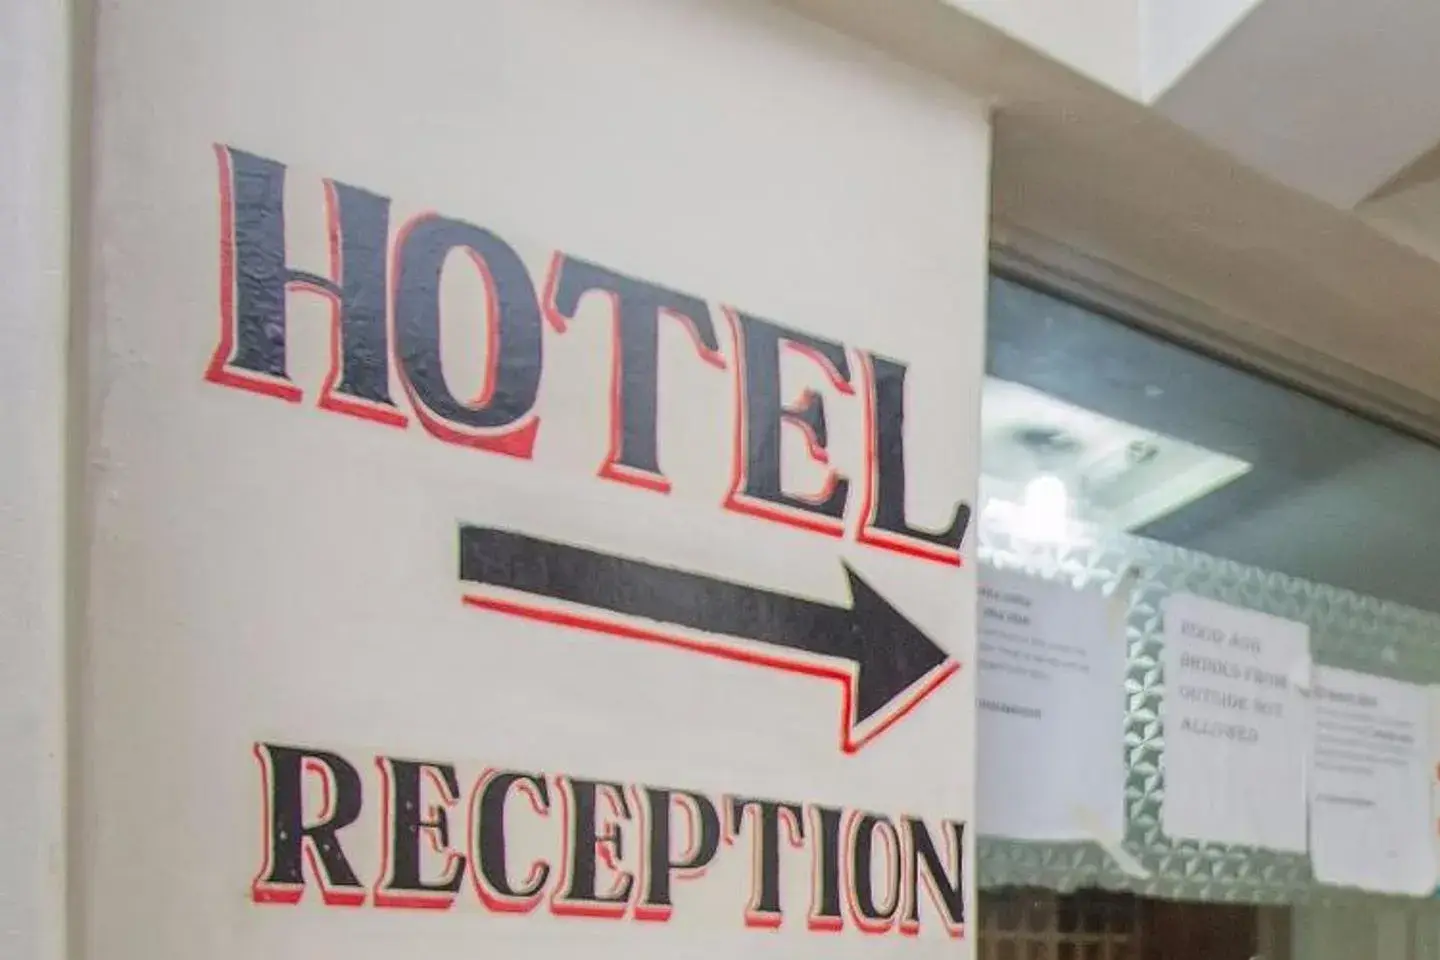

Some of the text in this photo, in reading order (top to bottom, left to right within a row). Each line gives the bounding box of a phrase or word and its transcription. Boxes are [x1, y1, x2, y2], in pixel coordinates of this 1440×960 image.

[206, 144, 970, 565] HOTEL
[1179, 686, 1249, 710] OUTSIDE
[1180, 716, 1259, 743] ALLOWED
[251, 741, 965, 938] RECEPTION
